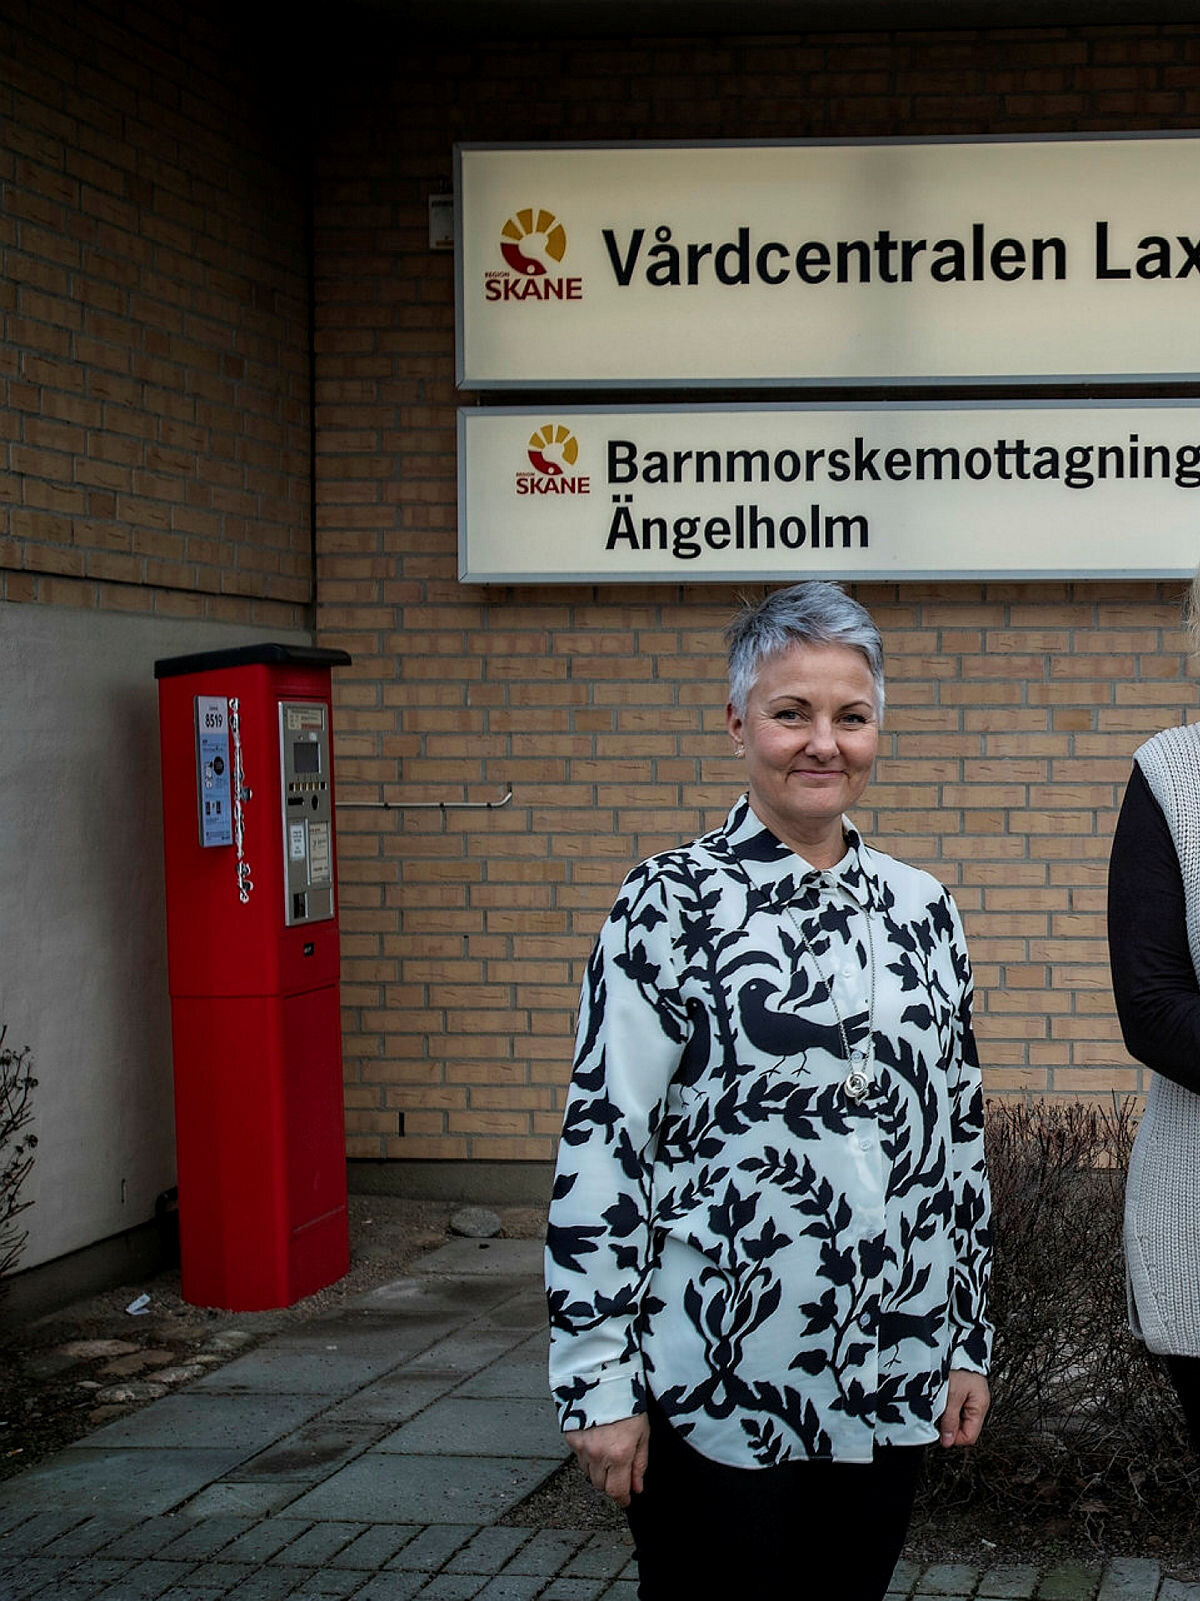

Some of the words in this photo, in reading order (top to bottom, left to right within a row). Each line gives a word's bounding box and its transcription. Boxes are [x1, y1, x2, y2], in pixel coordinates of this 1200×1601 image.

[601, 223, 1067, 287] Vårdcentralen
[605, 495, 869, 560] Ängelholm
[205, 713, 223, 728] 8519
